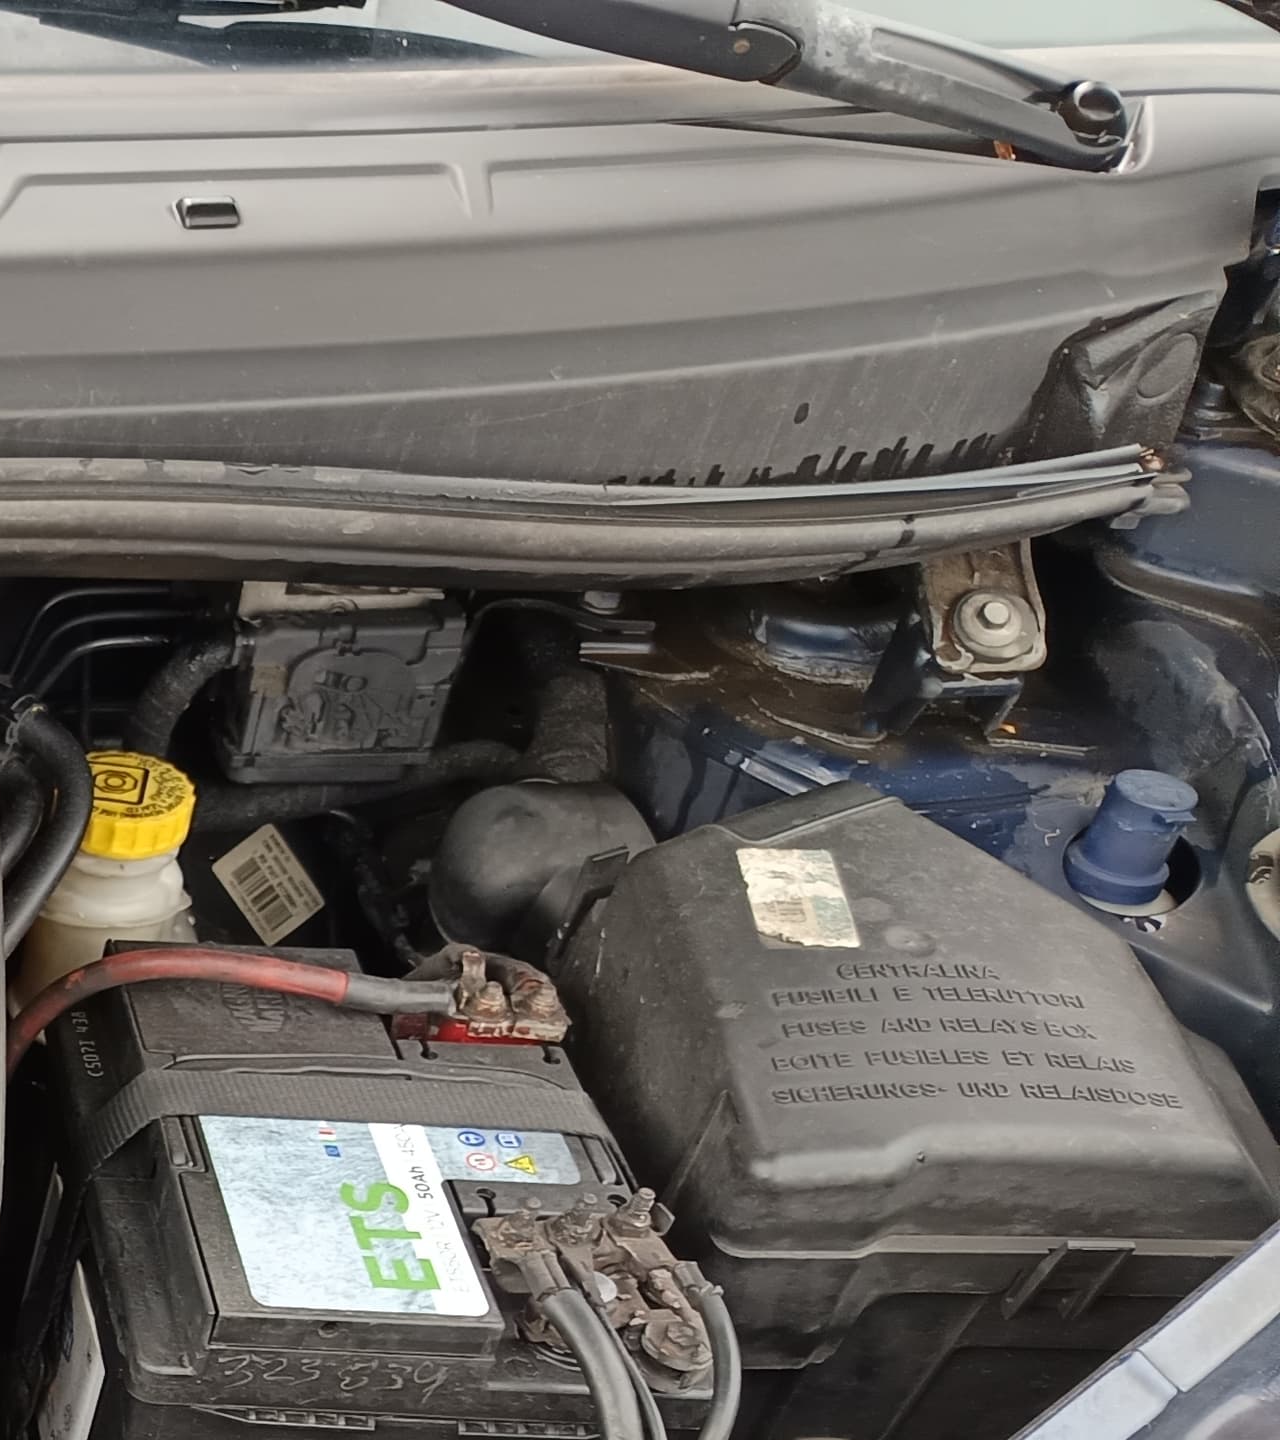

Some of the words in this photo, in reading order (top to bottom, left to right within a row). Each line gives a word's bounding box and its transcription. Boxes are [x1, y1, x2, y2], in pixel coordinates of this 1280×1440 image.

[836, 962, 1000, 981] CENTRALINA
[772, 987, 878, 1007] FUSIBILI
[893, 987, 912, 1004] E
[922, 986, 1086, 1009] TELERUTTORI
[782, 1018, 867, 1038] FUSES
[880, 1017, 933, 1035] AND
[941, 1017, 1039, 1037] RELAYS
[1047, 1021, 1098, 1041] BOX
[771, 1052, 853, 1073] BOITE
[866, 1049, 991, 1067] FUSIBLES
[1002, 1050, 1036, 1067] ET
[1047, 1053, 1137, 1075] RELAIS
[772, 1082, 947, 1105] SICHERUNGS-
[958, 1080, 1010, 1099] UND
[1021, 1082, 1185, 1110] RELAISDOSE
[408, 1165, 434, 1200] 50Ah
[339, 1182, 442, 1291] ETS
